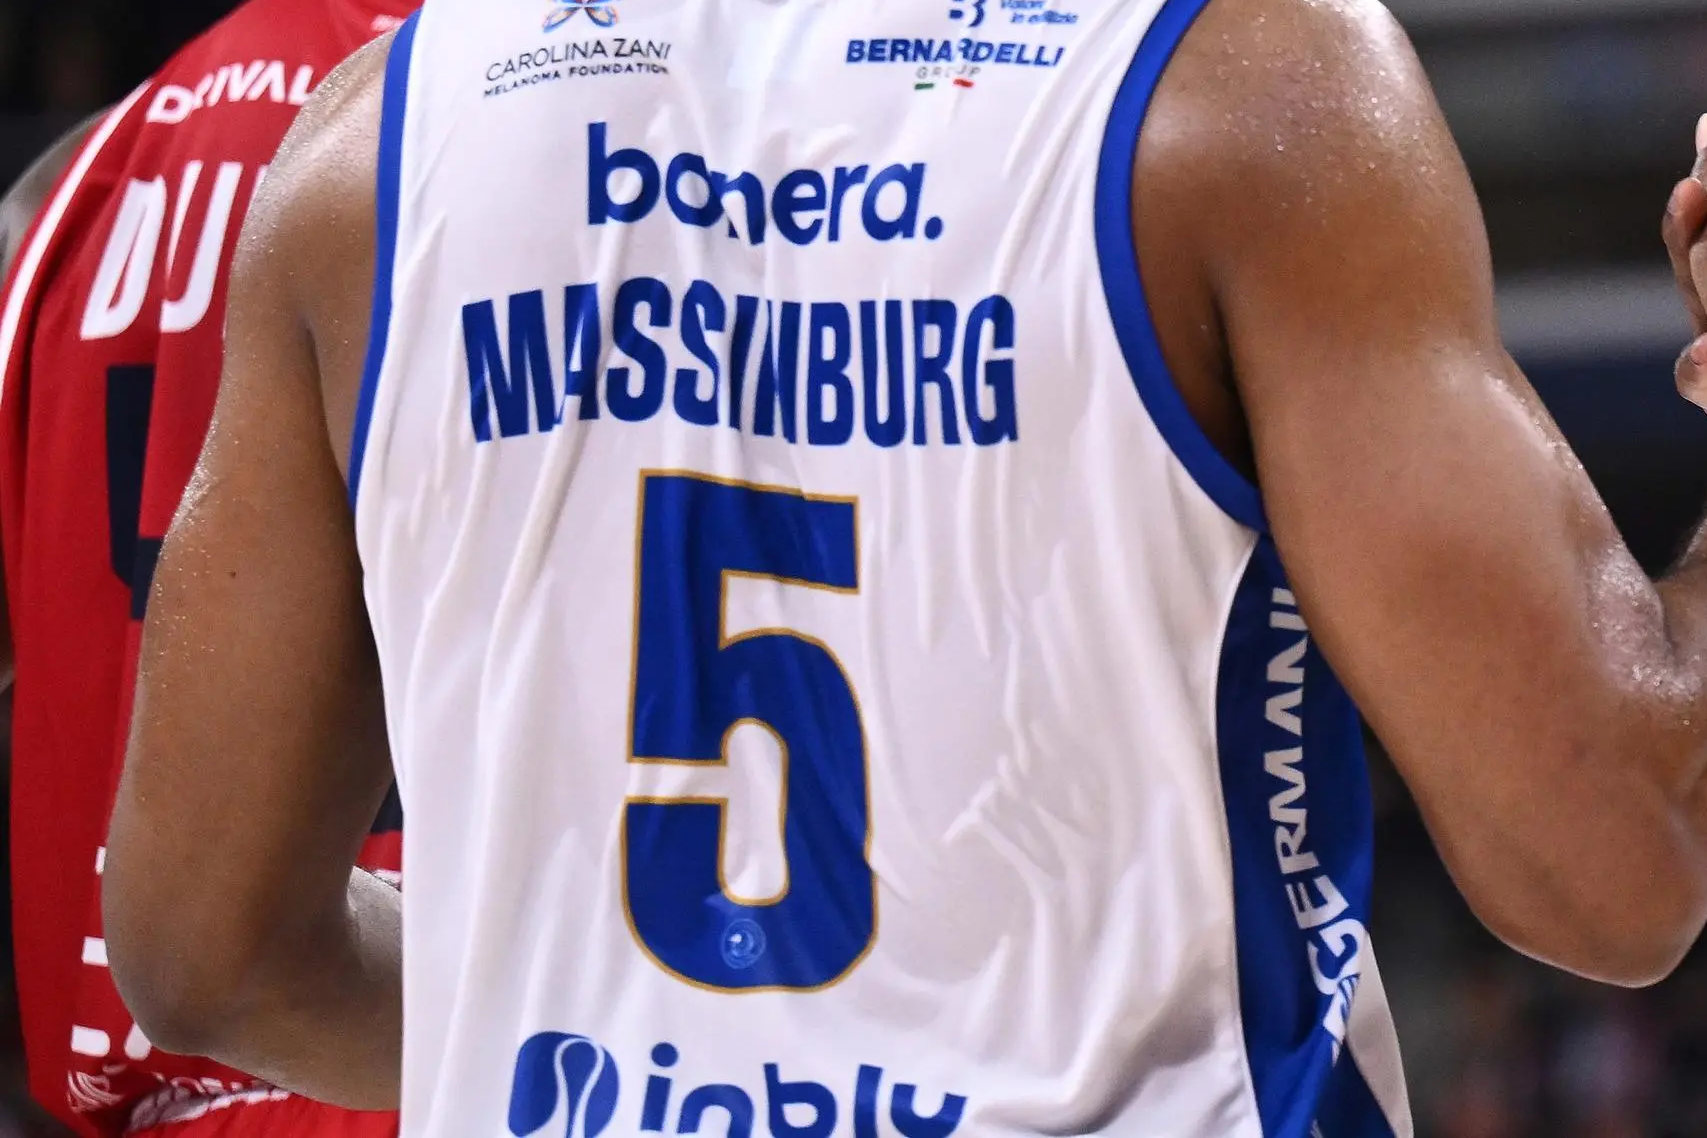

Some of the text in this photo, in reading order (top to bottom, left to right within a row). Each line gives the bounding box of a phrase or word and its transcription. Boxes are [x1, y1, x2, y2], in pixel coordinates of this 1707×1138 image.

[483, 70, 561, 98] MELANOMA
[486, 38, 671, 82] CAROLINA ZANI
[846, 37, 1066, 67] BERNARDELLI
[588, 122, 943, 246] bonera.
[462, 276, 1018, 448] MASSINBURG
[620, 468, 878, 995] 5
